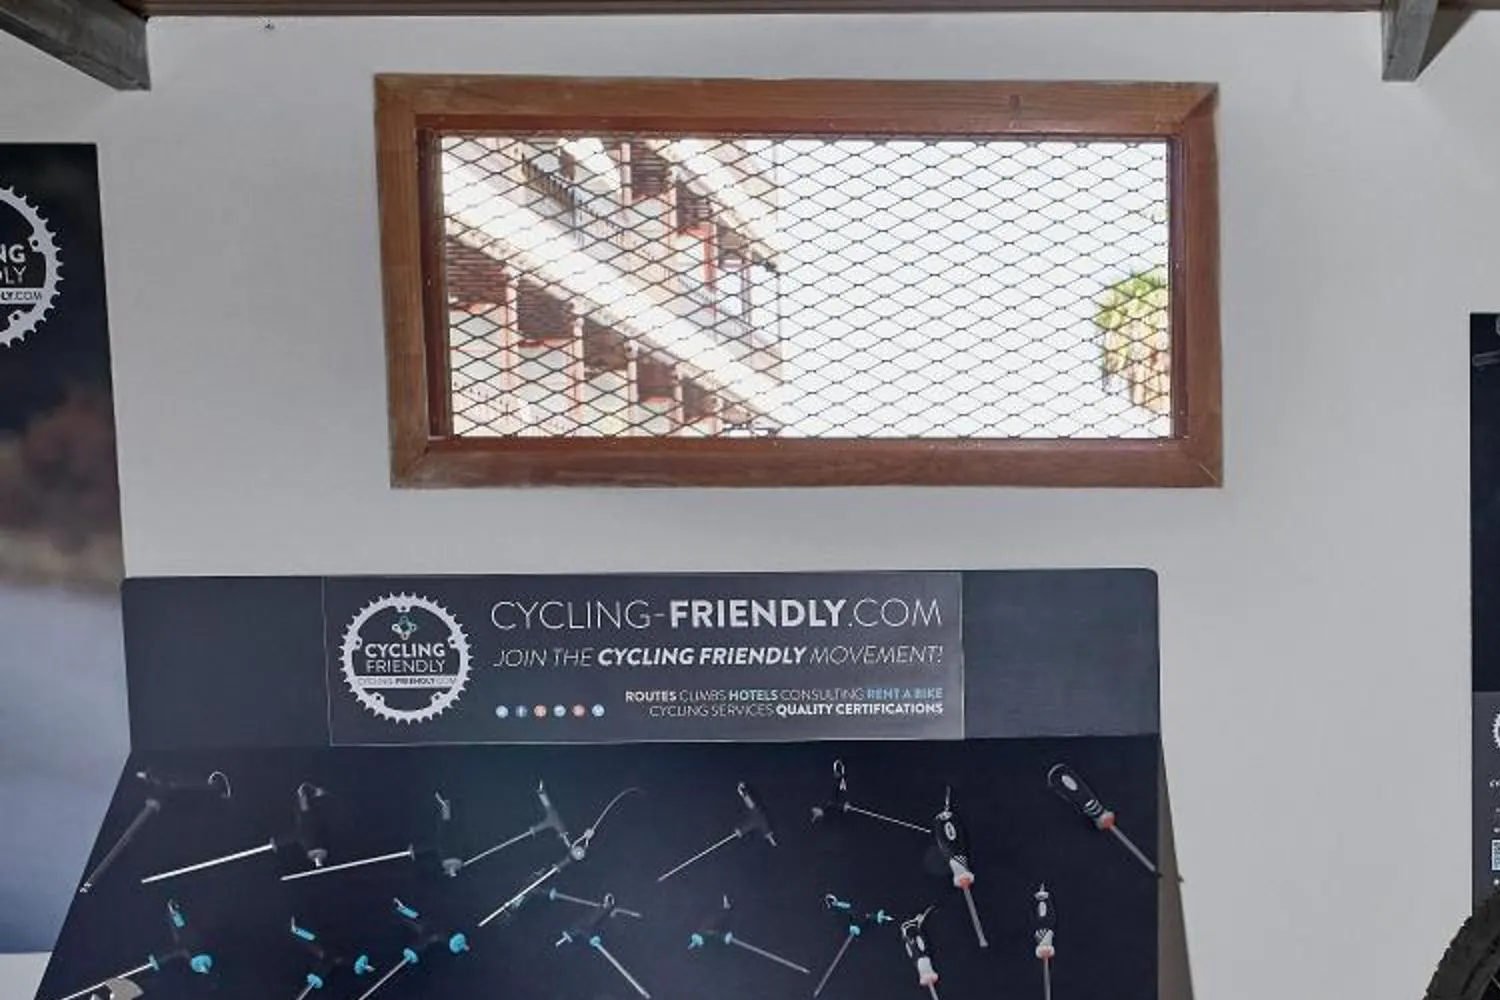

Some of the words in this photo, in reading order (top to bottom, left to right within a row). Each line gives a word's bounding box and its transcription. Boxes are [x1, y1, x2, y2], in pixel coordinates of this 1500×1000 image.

[491, 598, 943, 630] CYCLING-FRIENDLY.COM
[365, 643, 446, 658] CYCLING
[493, 649, 547, 667] JOIN
[552, 648, 594, 667] THE
[598, 648, 695, 666] CYCLING
[699, 647, 808, 666] FRIENDLY
[809, 646, 944, 665] MOVEMENT!
[366, 659, 446, 673] FRIENDLY
[625, 690, 677, 702] ROUTES
[729, 689, 779, 701] HOTELS
[780, 688, 865, 701] CONSULTING
[649, 705, 709, 717] CYCLING
[711, 704, 774, 717] SERVICES
[776, 703, 833, 719] QUALITY
[835, 702, 944, 716] CERTIFICATIONS
